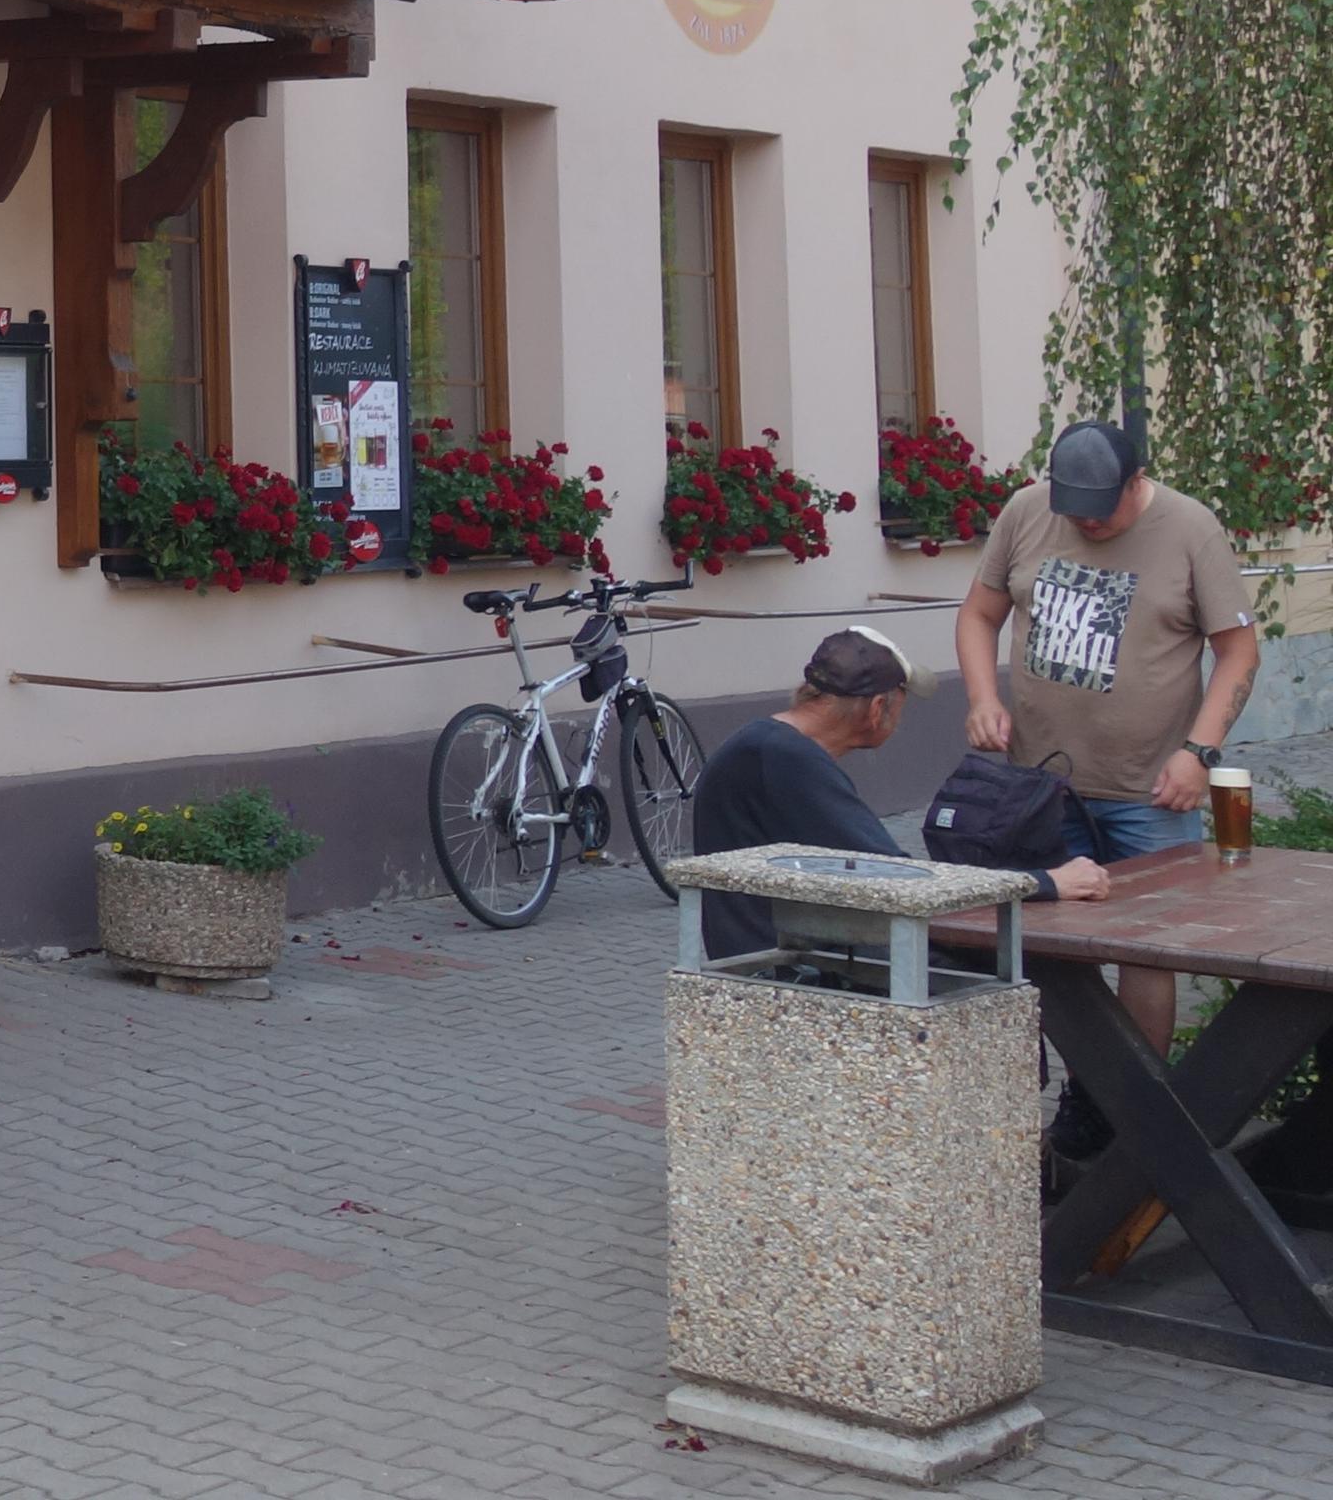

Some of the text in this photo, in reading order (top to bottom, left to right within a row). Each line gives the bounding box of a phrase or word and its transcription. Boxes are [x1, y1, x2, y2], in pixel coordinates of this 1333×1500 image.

[309, 332, 373, 351] RESTAURACE
[1031, 580, 1104, 634] HIKE
[1035, 621, 1116, 676] TRAIL
